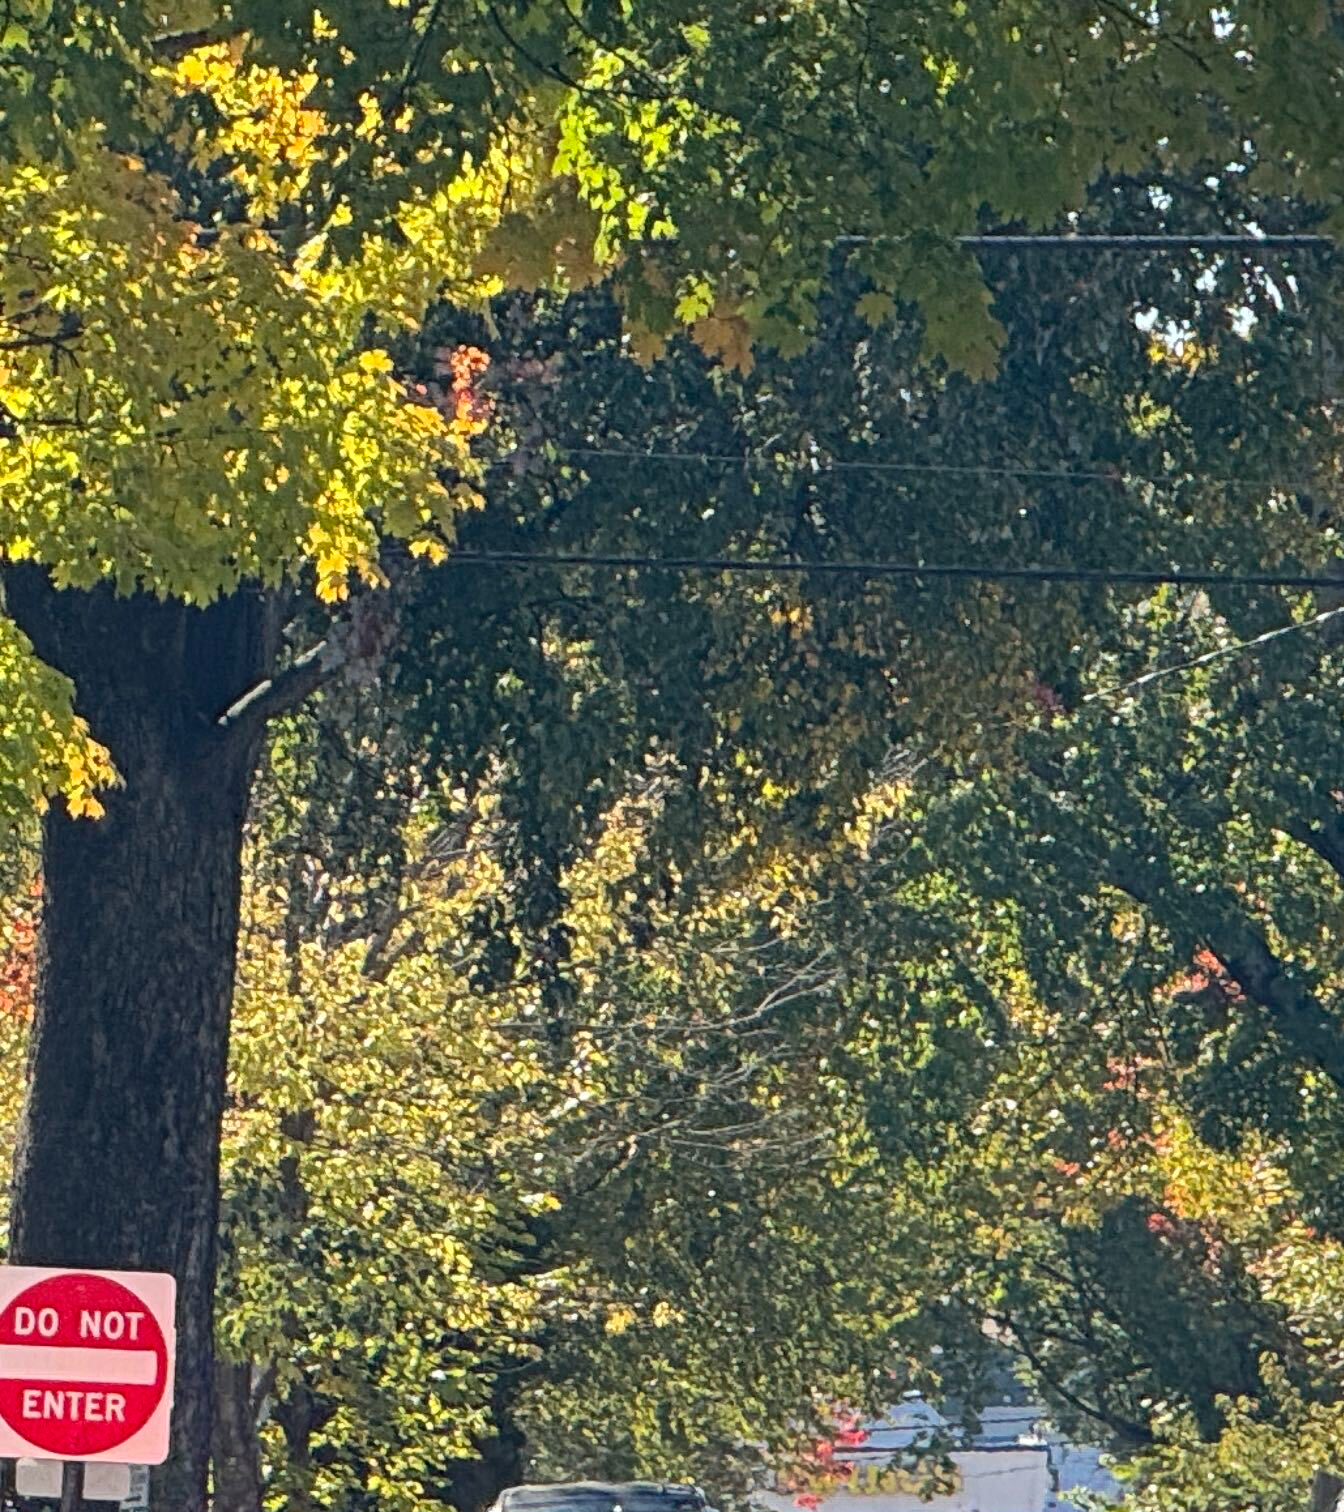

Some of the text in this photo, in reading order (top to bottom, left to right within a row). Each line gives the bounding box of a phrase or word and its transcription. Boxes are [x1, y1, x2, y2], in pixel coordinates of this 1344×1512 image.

[14, 1306, 145, 1341] DO NOT
[22, 1389, 127, 1422] ENTER
